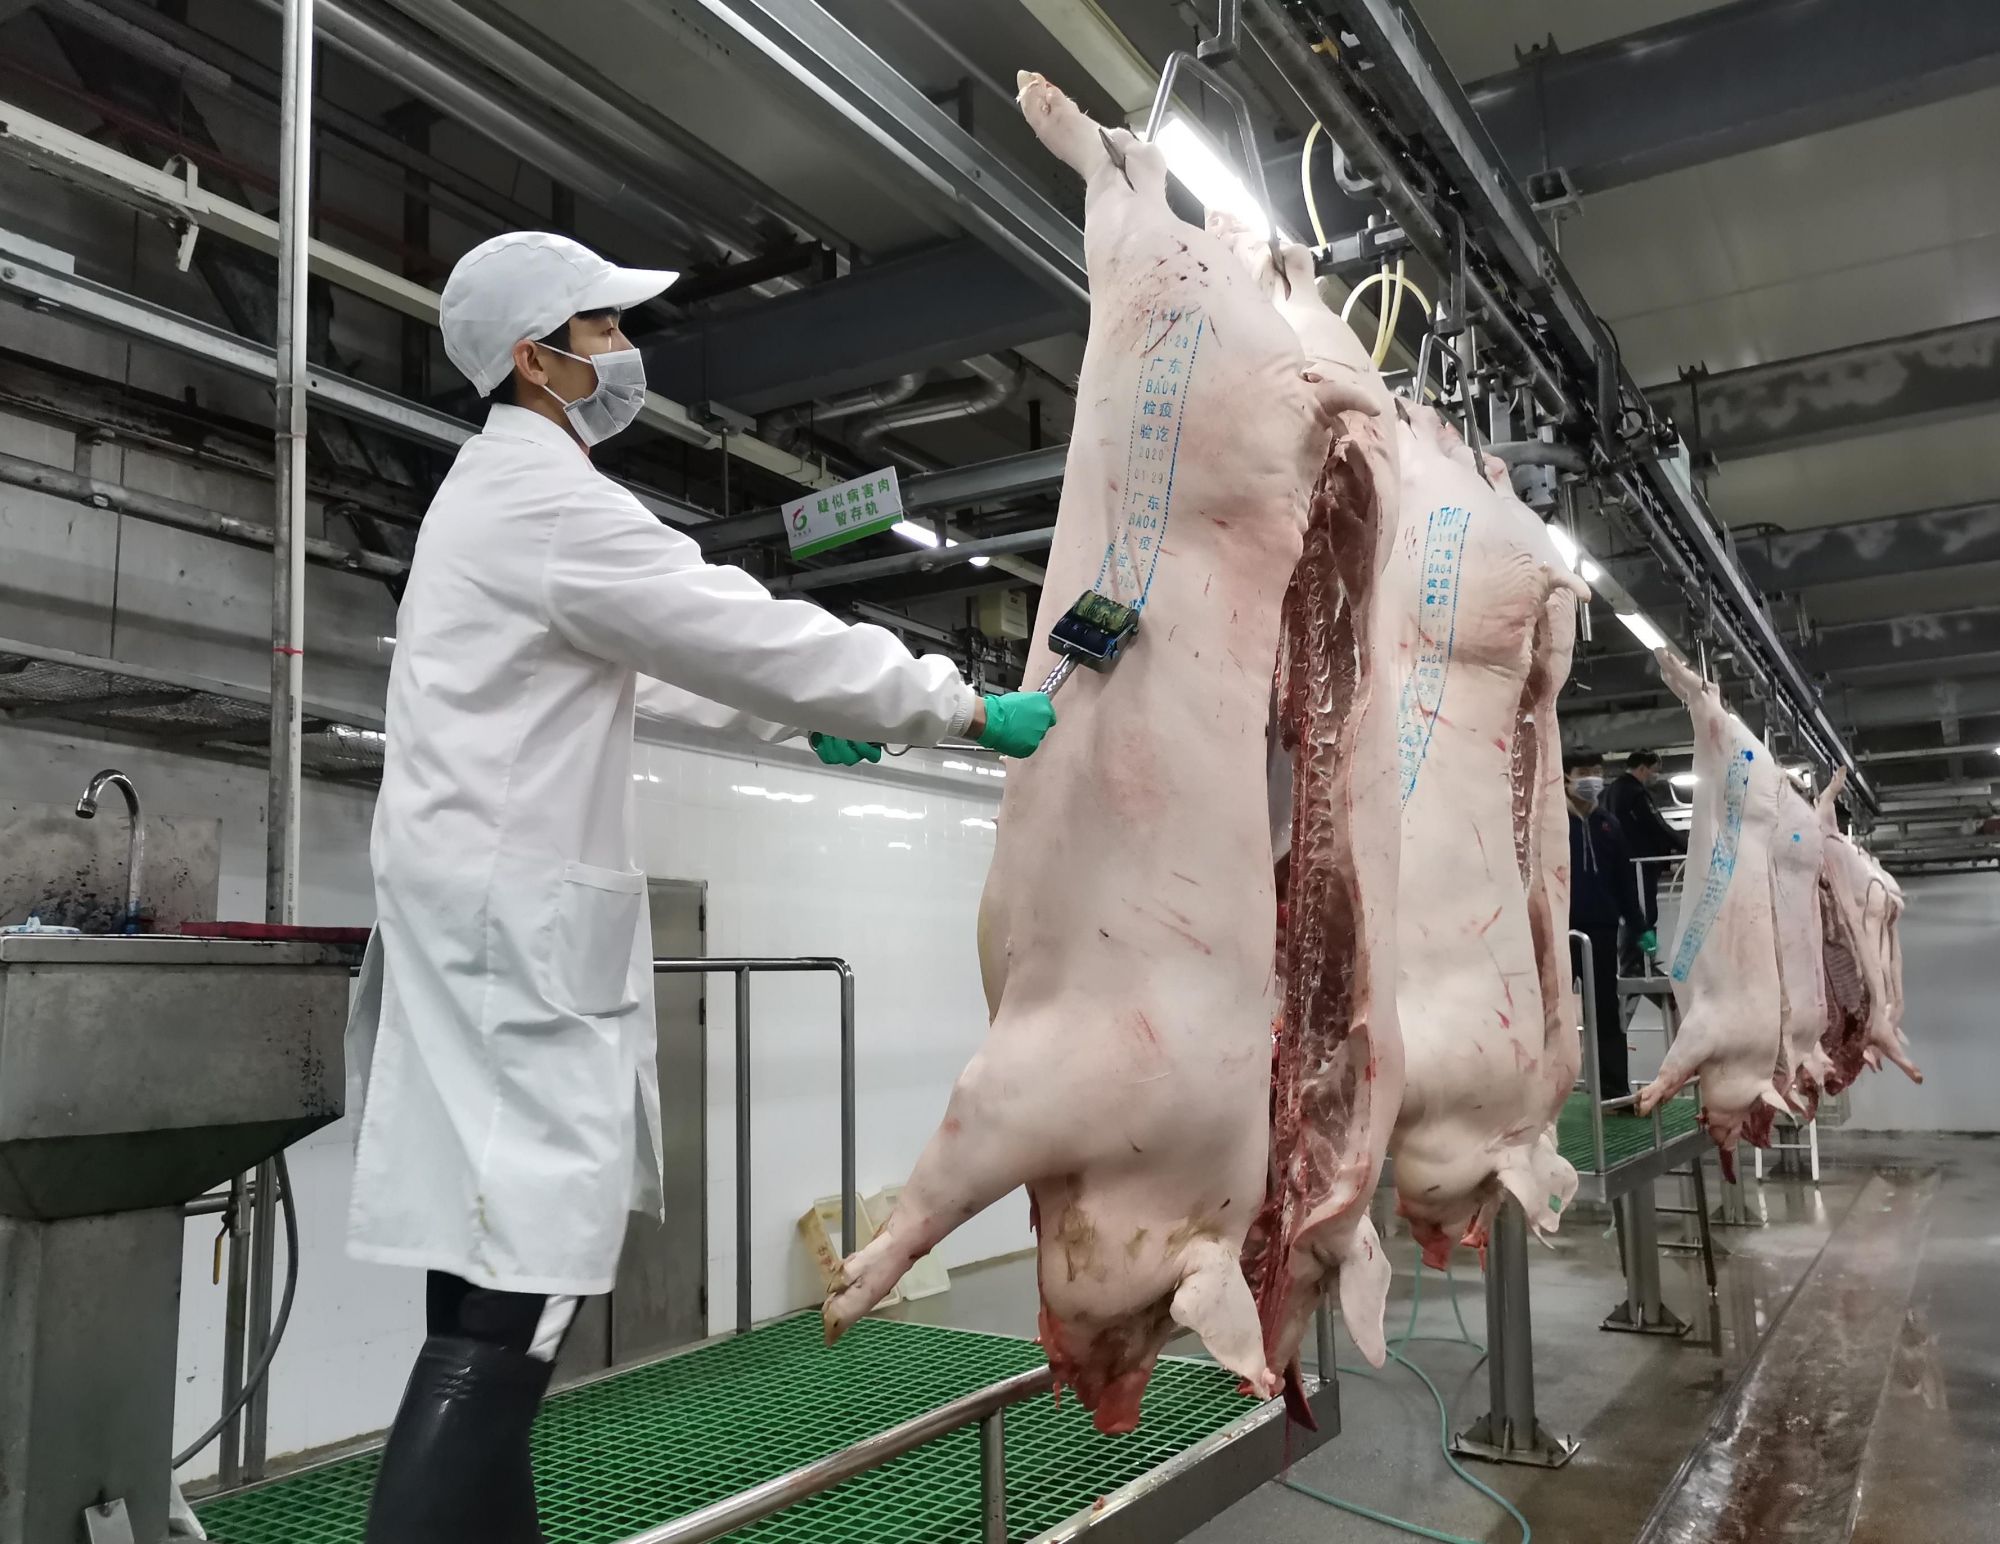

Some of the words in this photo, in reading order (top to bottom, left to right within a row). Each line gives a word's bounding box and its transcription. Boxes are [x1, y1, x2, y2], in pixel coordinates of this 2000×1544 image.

[1150, 357, 1182, 374] 广东
[1145, 379, 1177, 396] BA04
[1143, 400, 1173, 418] 检疫
[816, 478, 890, 514] 疑似病害肉
[1132, 492, 1160, 510] 广东
[1128, 512, 1157, 529] BA04
